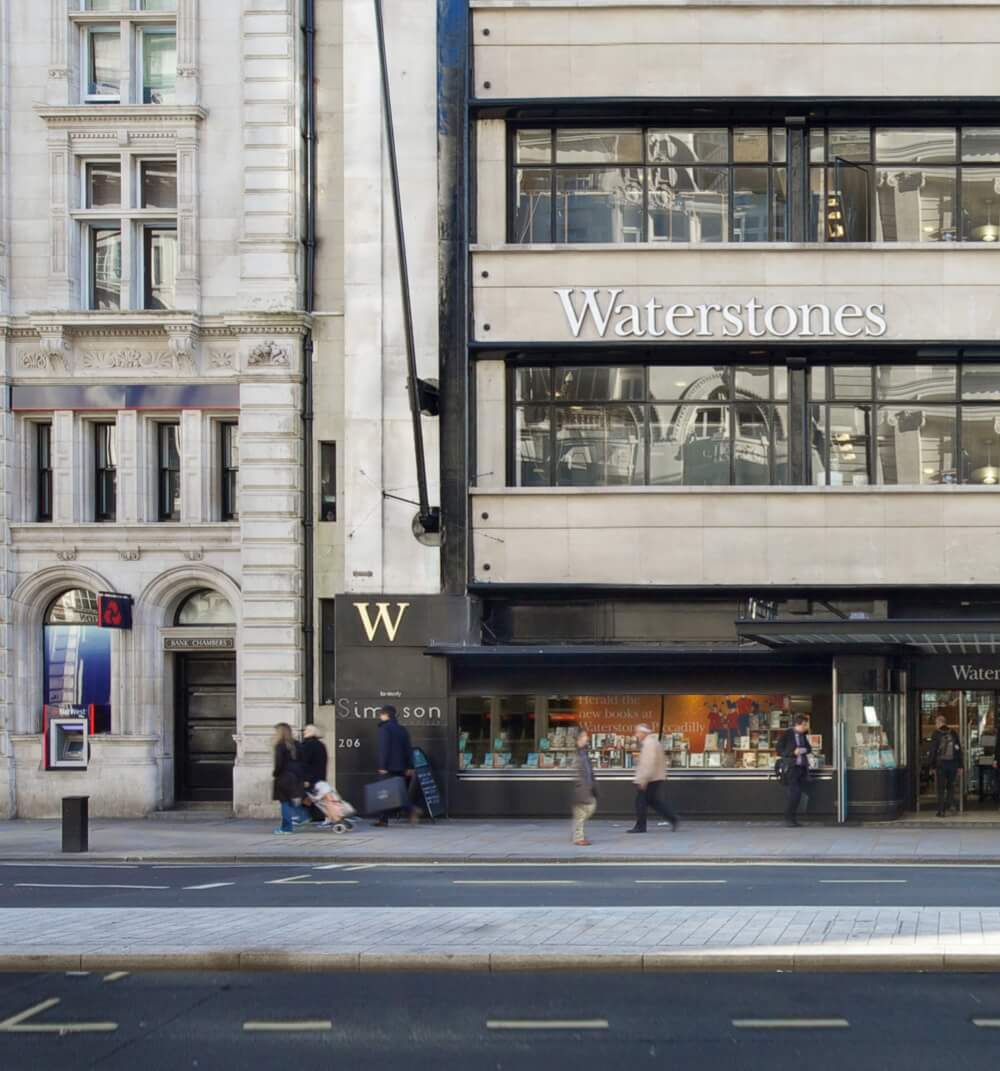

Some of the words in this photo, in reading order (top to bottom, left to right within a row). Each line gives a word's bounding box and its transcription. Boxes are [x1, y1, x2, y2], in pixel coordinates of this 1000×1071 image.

[554, 288, 887, 337] Waterstones
[353, 602, 410, 642] W
[171, 639, 188, 648] BANK
[192, 639, 227, 648] CHAMBERS
[338, 698, 441, 719] Simson
[604, 708, 638, 718] books
[641, 710, 653, 718] at
[338, 739, 361, 749] 206
